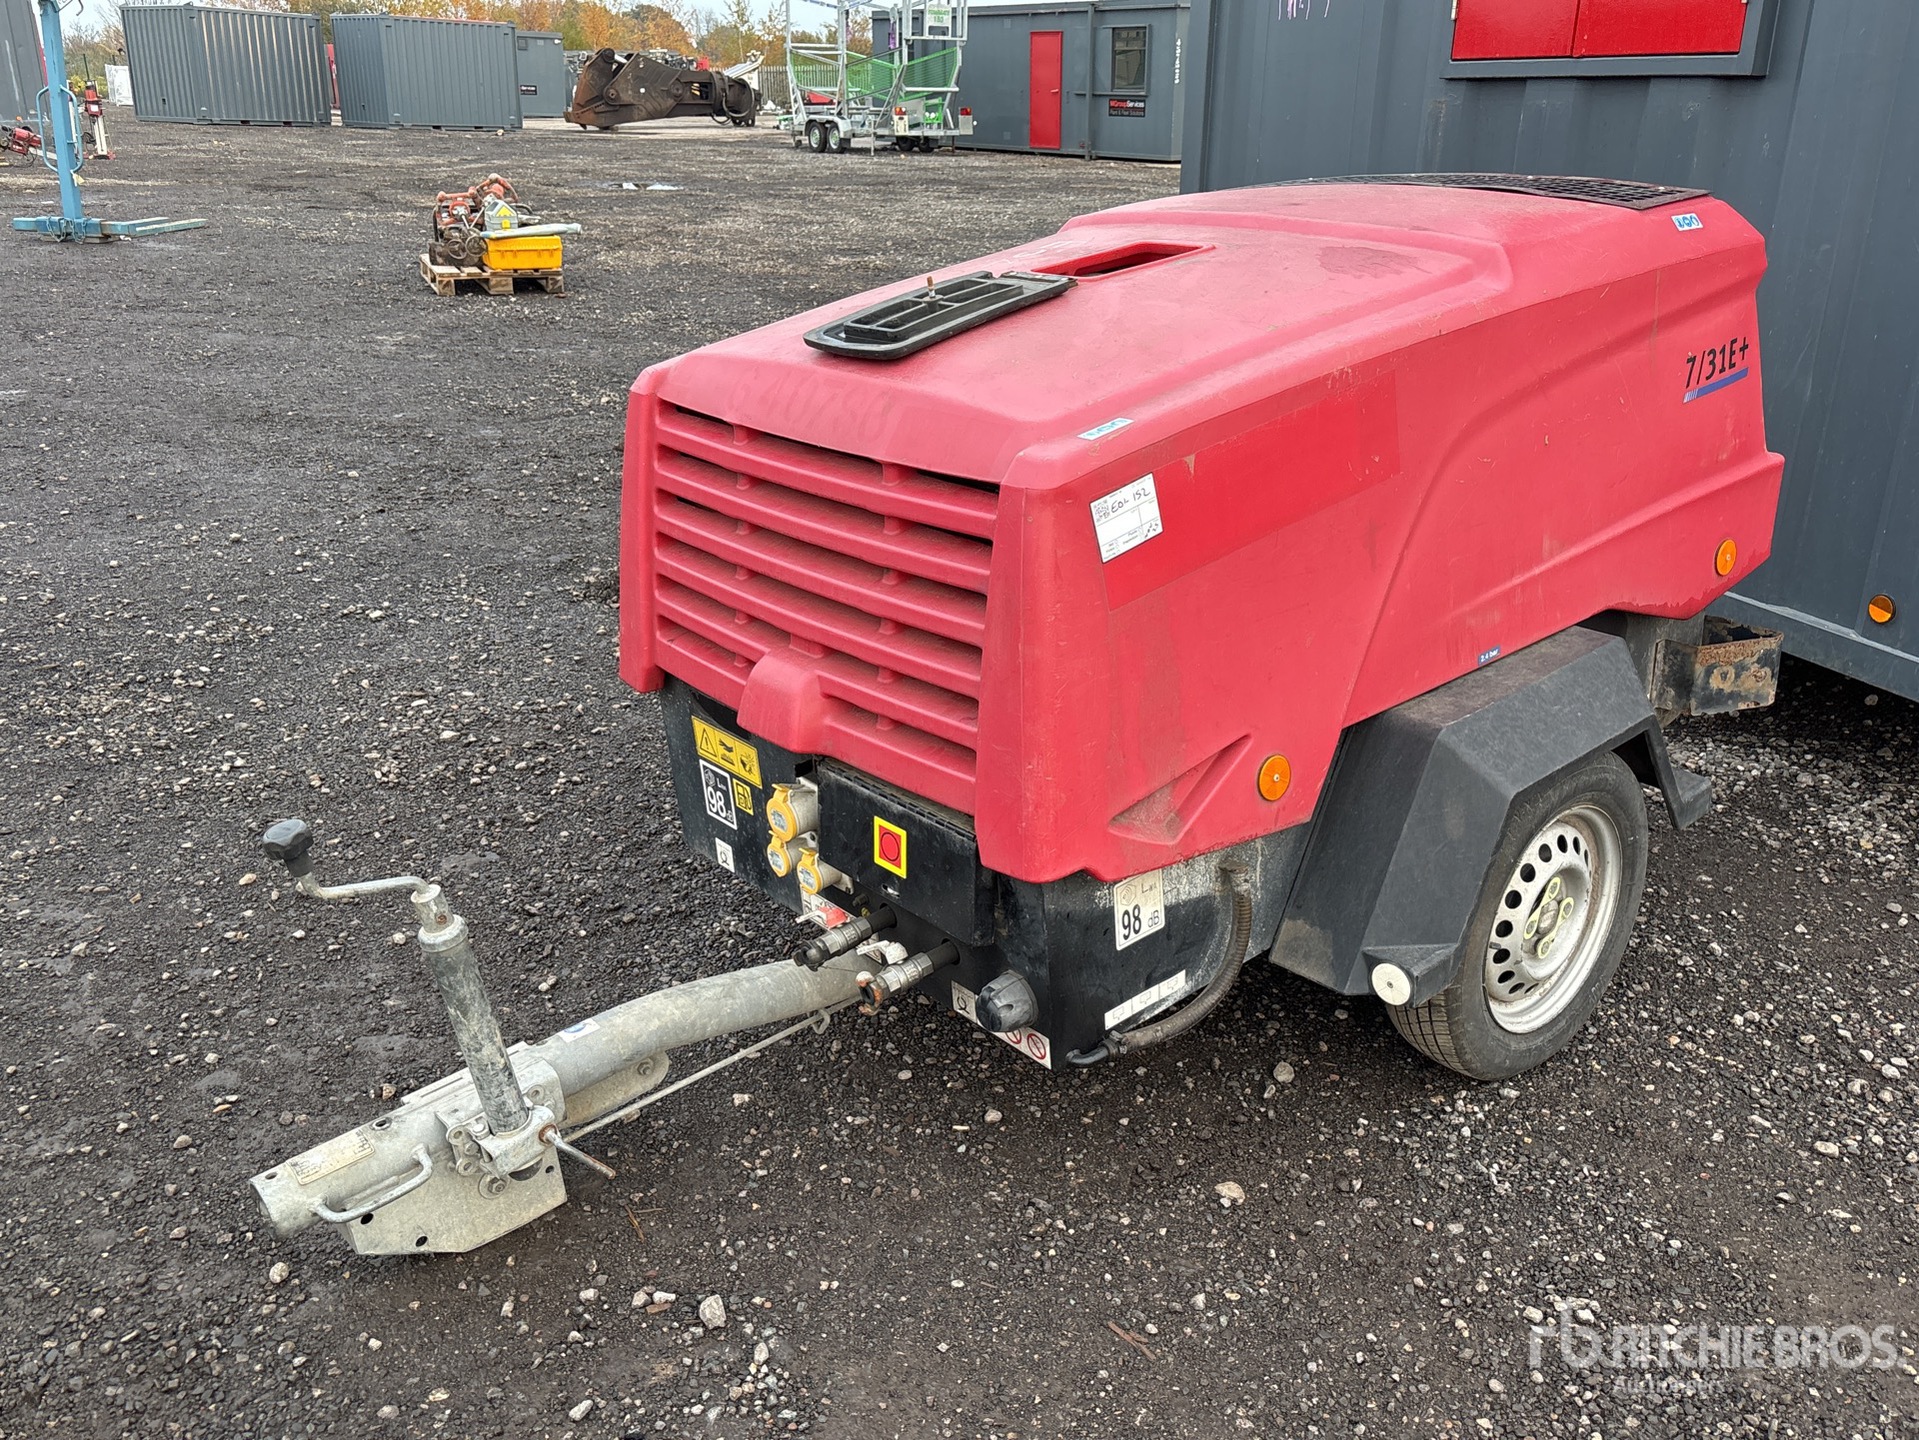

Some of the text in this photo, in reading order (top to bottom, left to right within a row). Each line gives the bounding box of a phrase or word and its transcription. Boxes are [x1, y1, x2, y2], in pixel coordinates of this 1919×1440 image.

[1686, 336, 1749, 389] 7/31E+
[707, 786, 727, 818] 98
[1122, 903, 1160, 941] 98 dB
